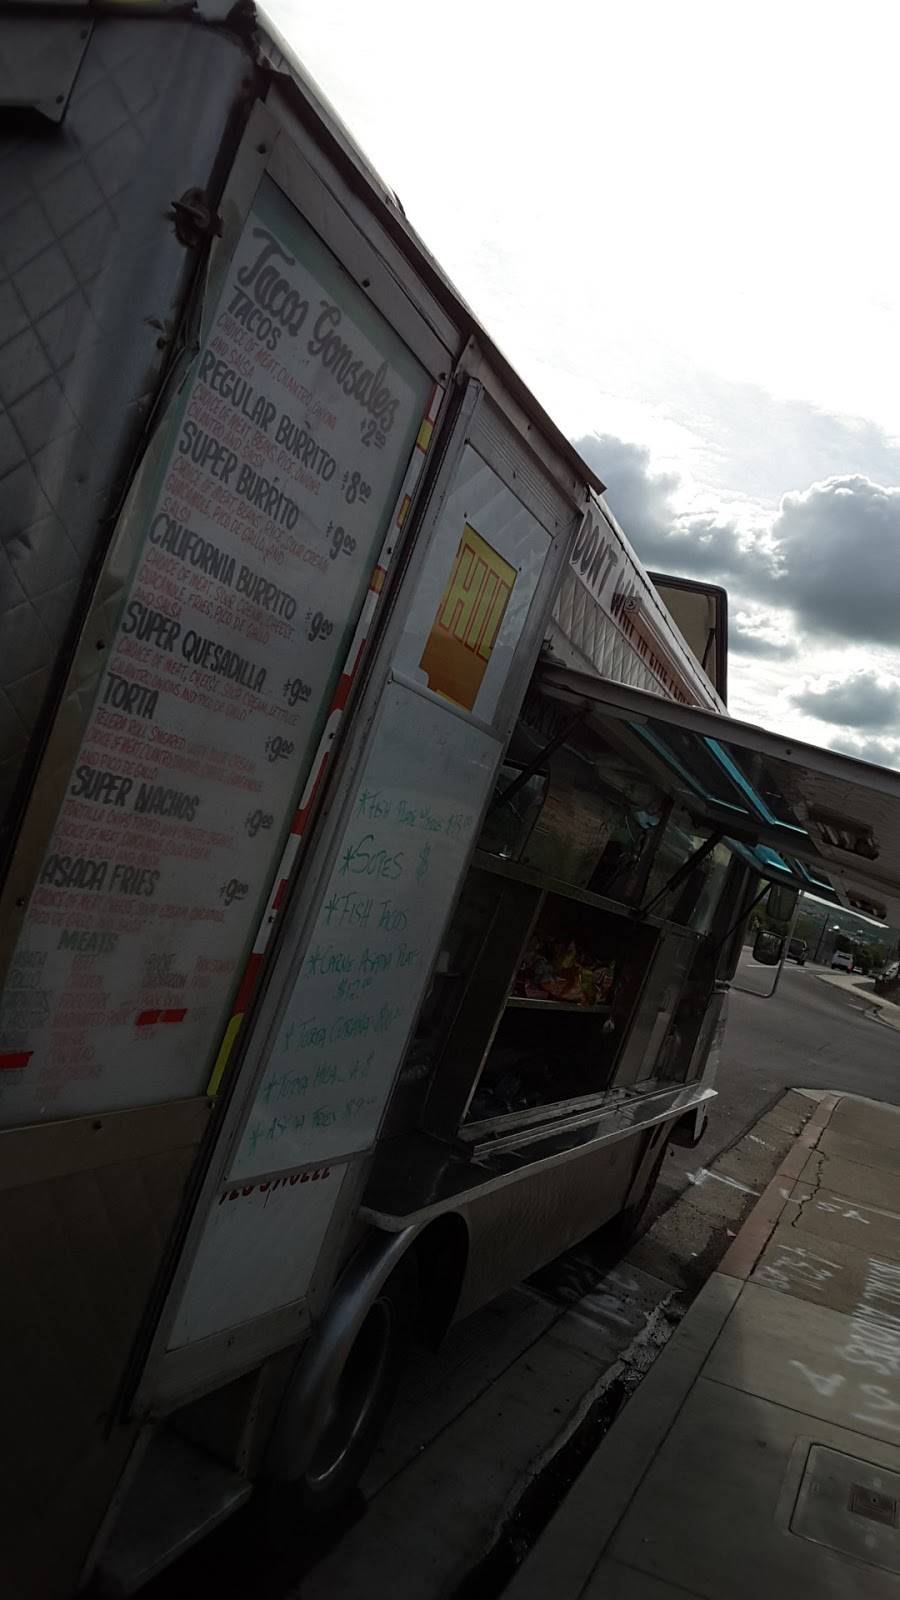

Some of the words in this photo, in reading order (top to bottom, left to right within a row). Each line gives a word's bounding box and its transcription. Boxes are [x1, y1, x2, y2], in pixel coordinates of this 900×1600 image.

[228, 285, 281, 350] TACOS
[243, 334, 256, 355] OF
[199, 350, 276, 432] REGULAR
[275, 415, 336, 481] BURRITO
[179, 421, 237, 484] SUPER
[236, 464, 300, 530] BURRITO
[149, 513, 235, 586] CALIFORNIA
[236, 566, 296, 620] BURRITO
[122, 601, 181, 652] SUPER
[179, 630, 267, 693] QUESADILLA
[103, 672, 159, 719] TORTA
[71, 766, 133, 807] SUPER
[134, 783, 199, 821] NACHOS
[40, 855, 107, 891] ASADA
[109, 865, 160, 896] FRIES
[333, 891, 375, 927] FISH
[57, 931, 118, 952] MEATS
